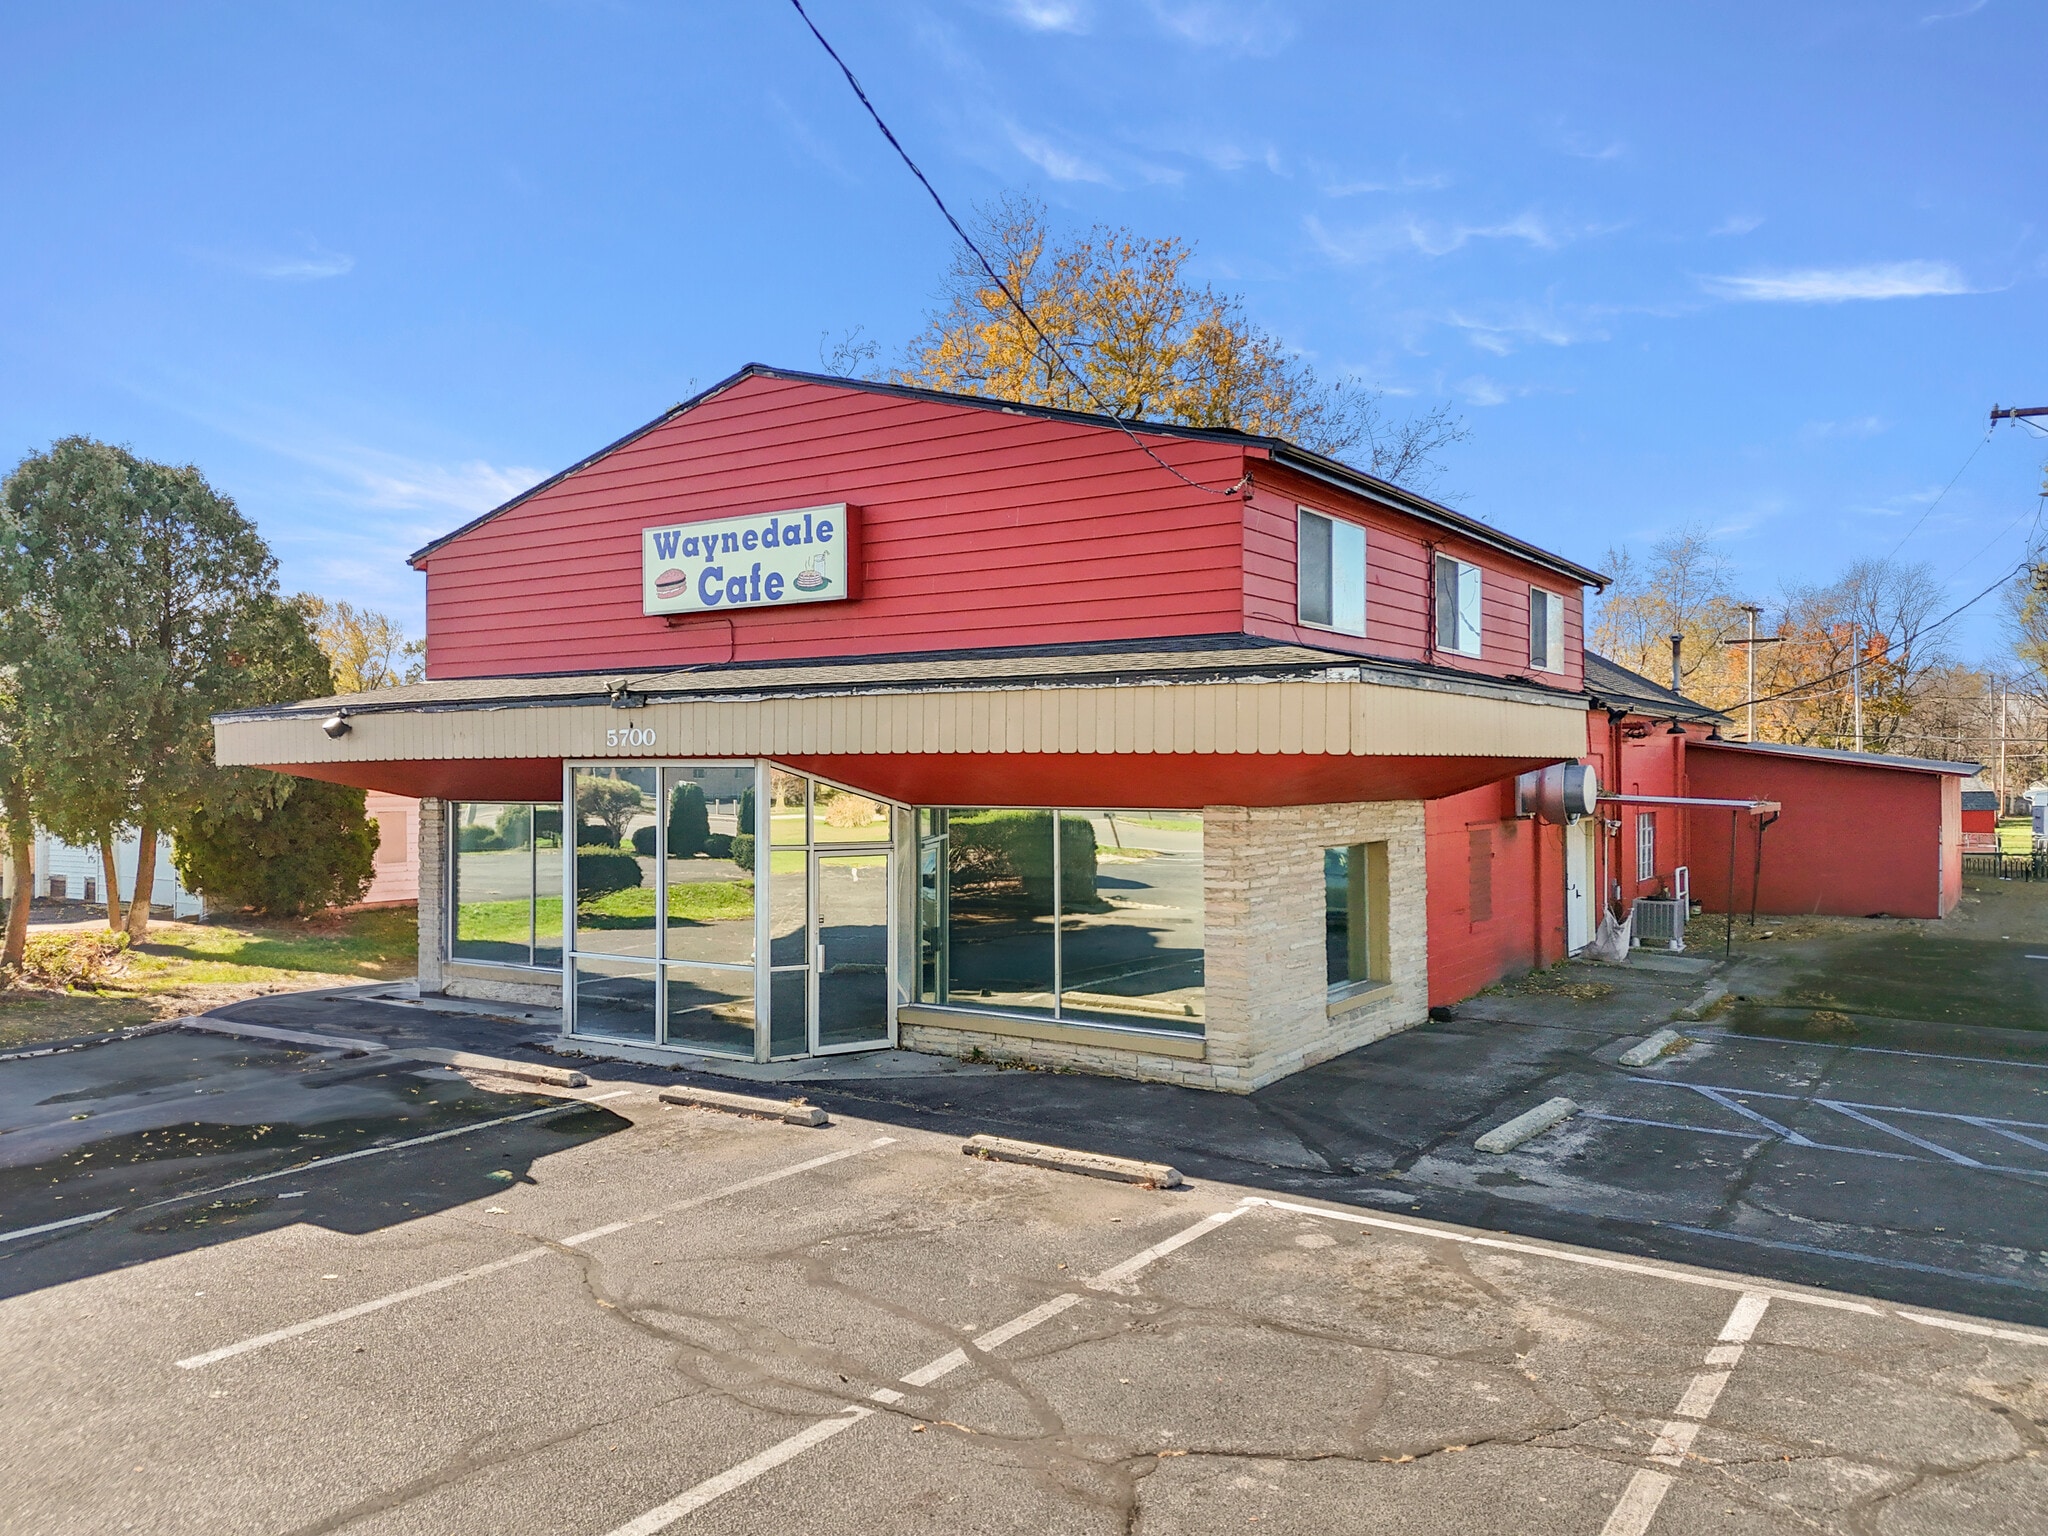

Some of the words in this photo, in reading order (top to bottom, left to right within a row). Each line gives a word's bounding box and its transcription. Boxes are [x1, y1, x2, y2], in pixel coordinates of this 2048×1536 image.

[653, 514, 834, 562] Waynedale
[698, 562, 784, 606] Cafe
[607, 728, 656, 747] 5700
